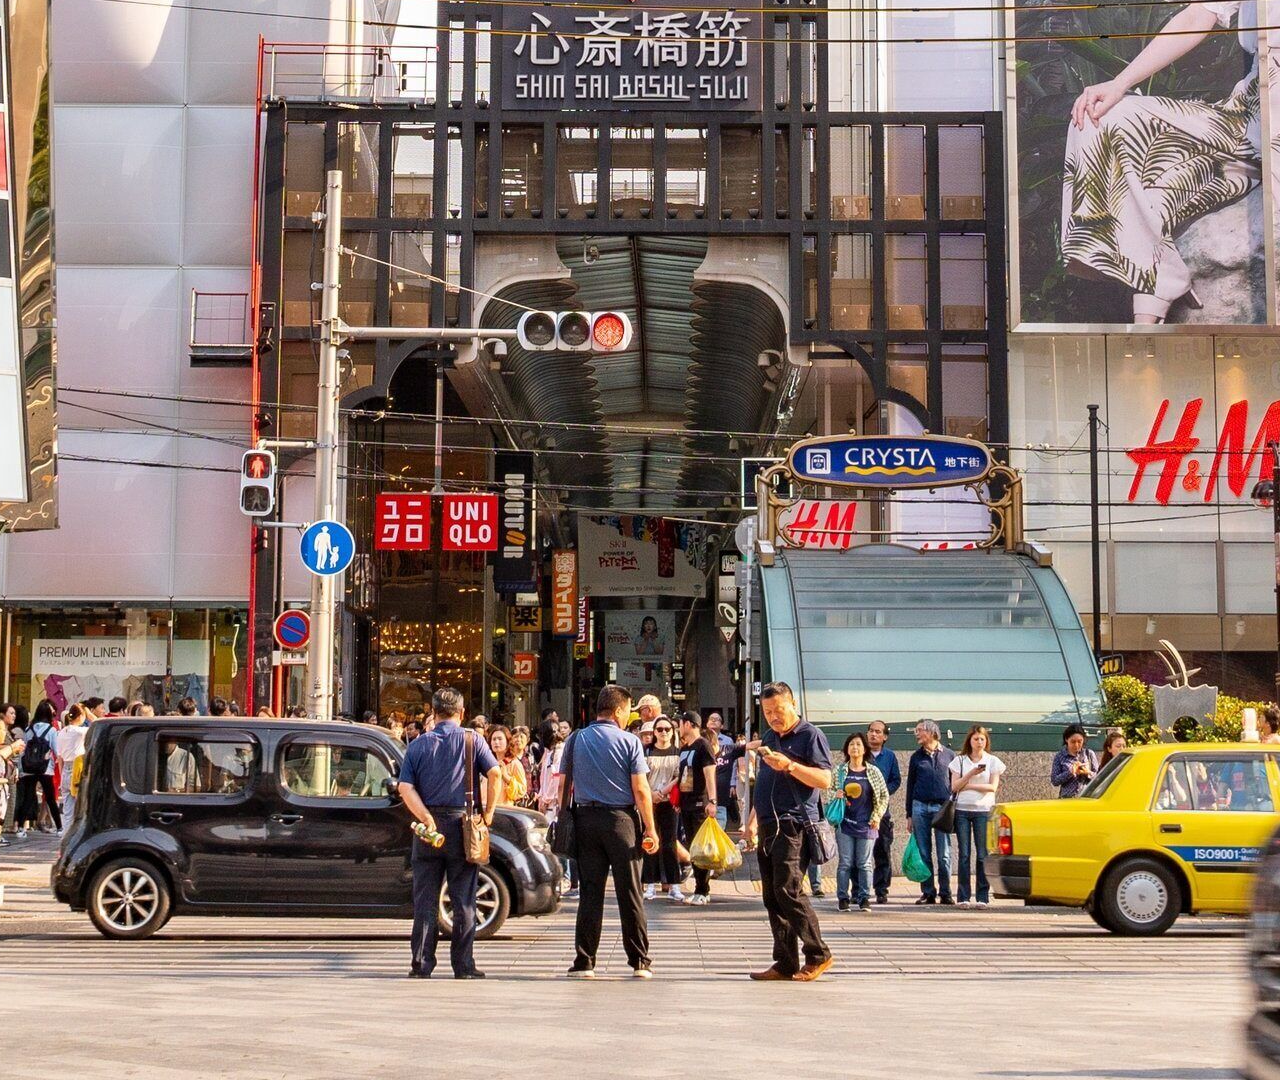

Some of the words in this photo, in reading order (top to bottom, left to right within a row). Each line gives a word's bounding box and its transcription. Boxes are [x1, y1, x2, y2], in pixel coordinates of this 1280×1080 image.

[513, 10, 752, 68] 心斎橋筋
[516, 74, 565, 99] SHIN
[844, 447, 936, 466] CRYSTA
[944, 456, 980, 468] 地下街
[383, 500, 423, 520] ユニ
[449, 501, 488, 521] UNI
[381, 523, 423, 543] クロ
[787, 501, 858, 549] H&M
[449, 524, 492, 547] QLO
[39, 646, 89, 658] PREMIUM
[92, 646, 126, 658] LINEN
